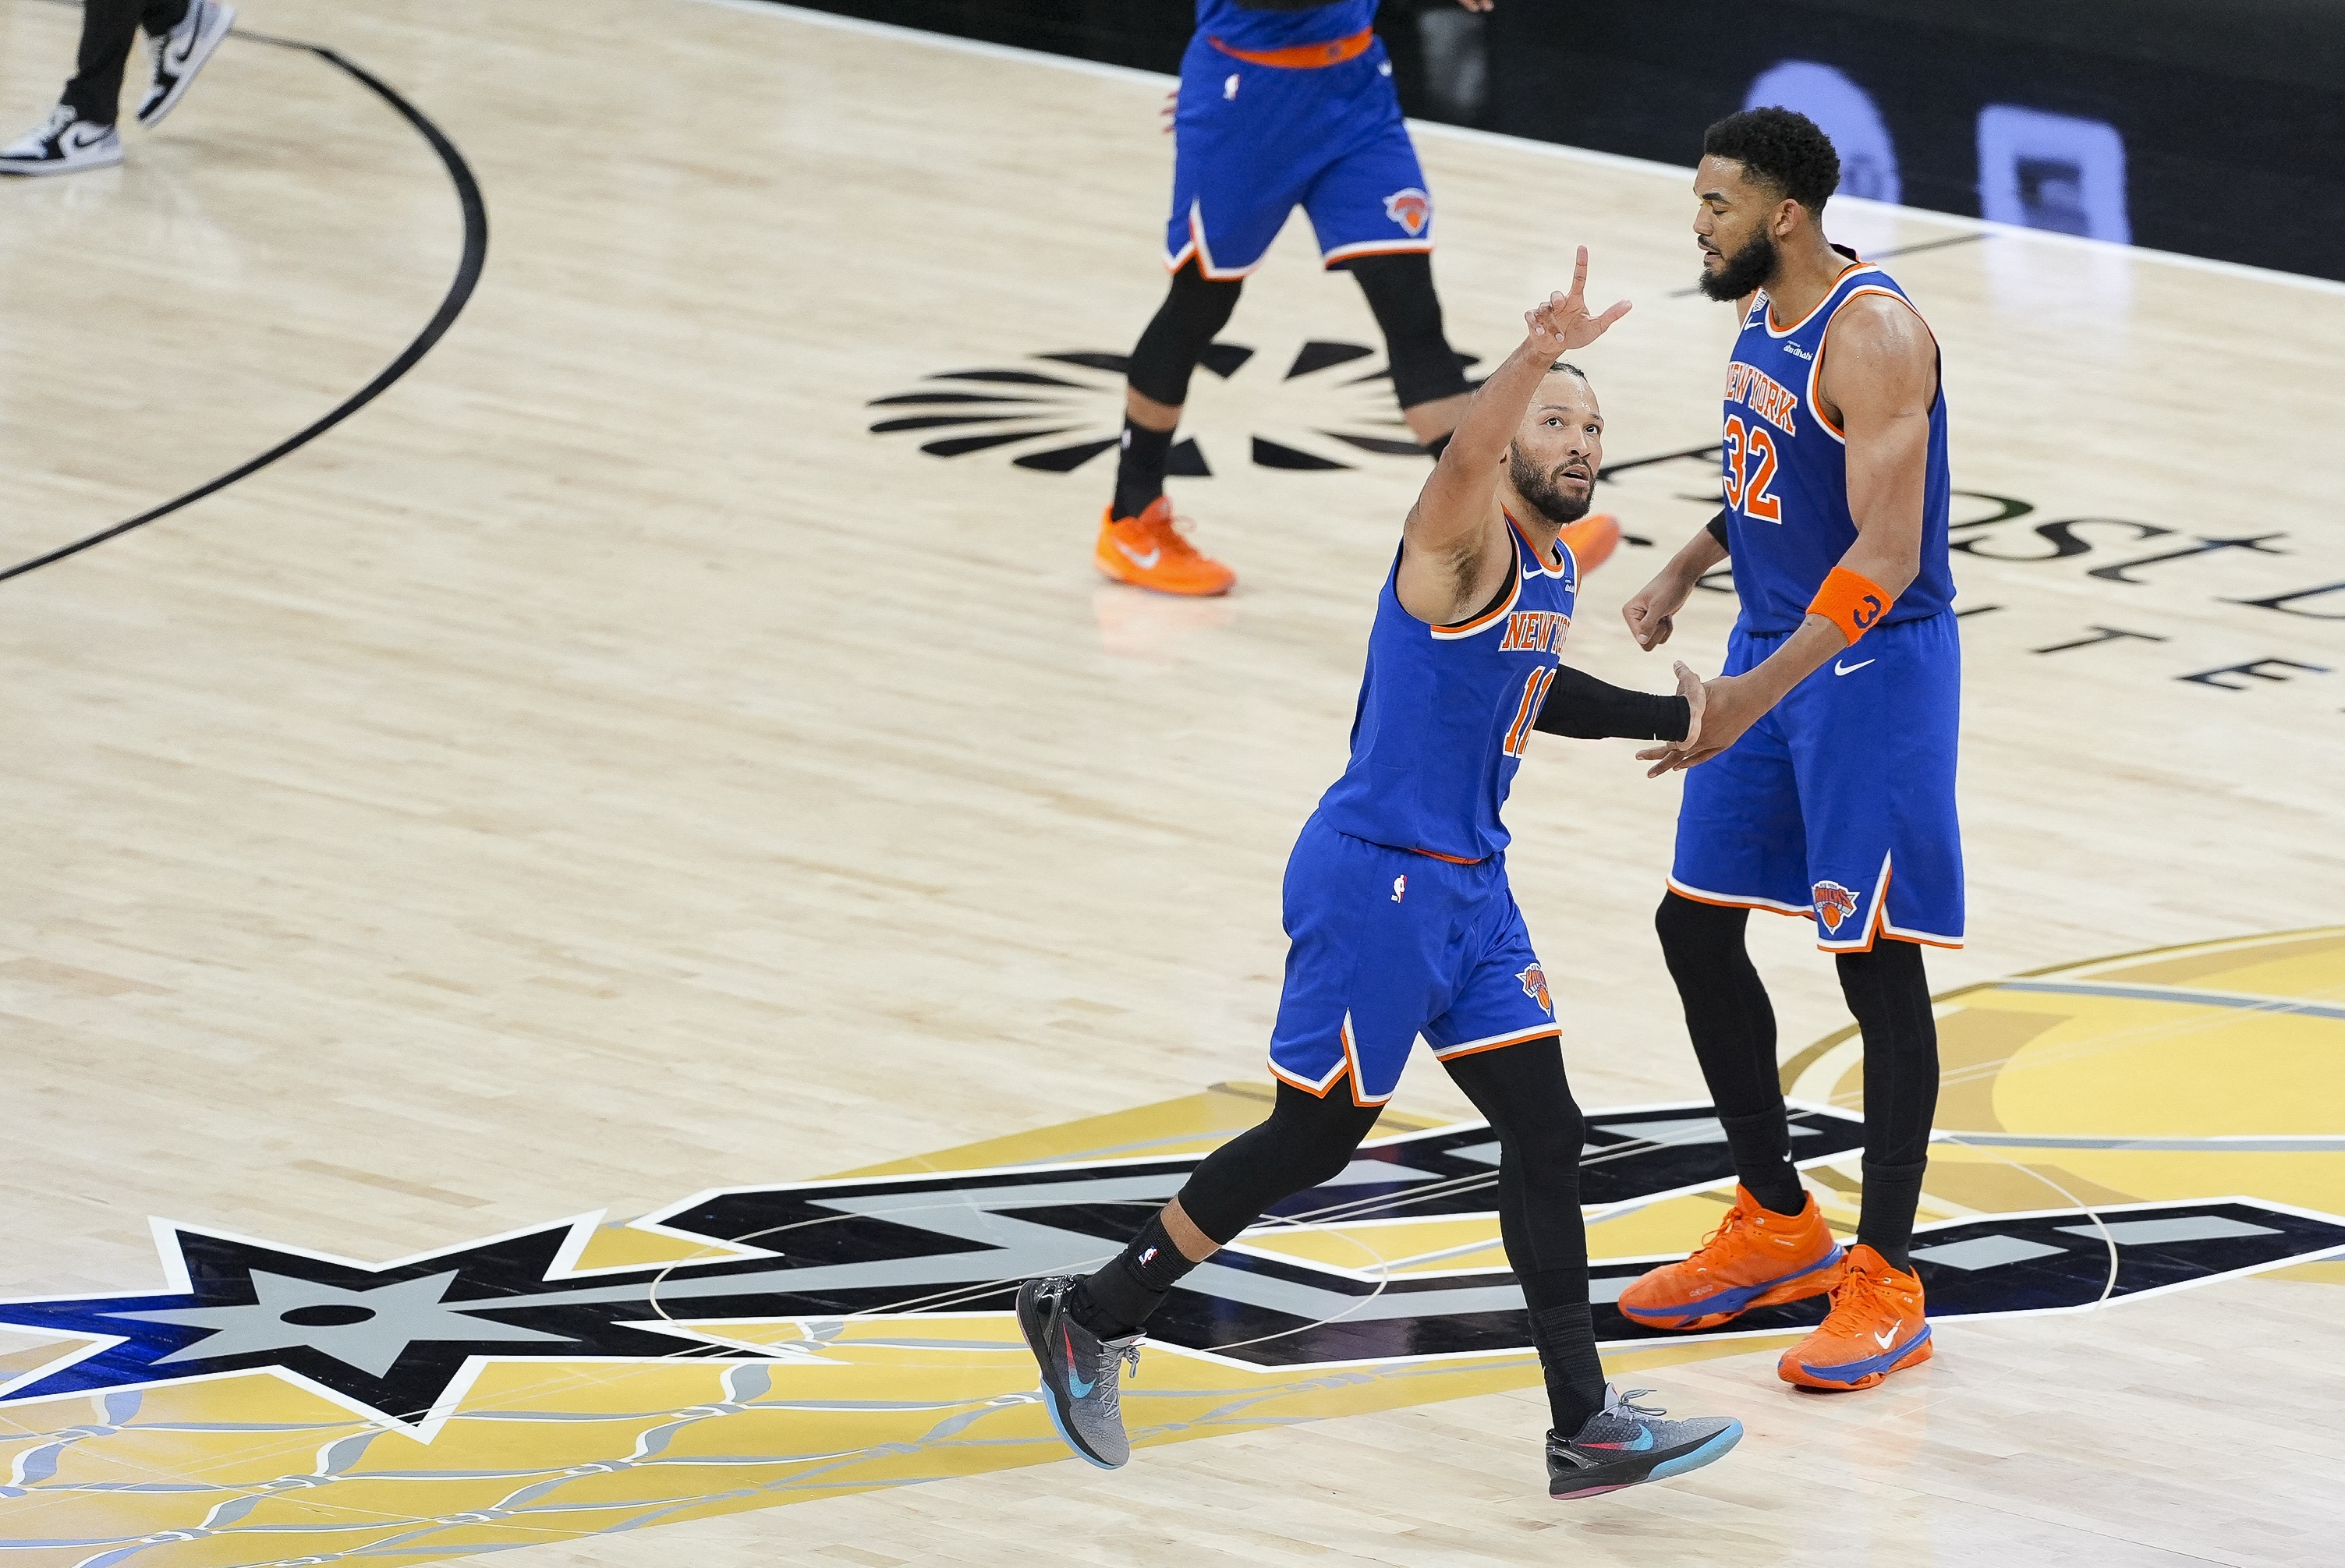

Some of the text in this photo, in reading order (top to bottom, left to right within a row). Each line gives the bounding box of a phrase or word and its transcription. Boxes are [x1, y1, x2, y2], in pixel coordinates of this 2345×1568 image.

[1748, 364, 1798, 437] YORK
[1722, 413, 1782, 525] 32
[1498, 611, 1556, 653] NEW
[1502, 665, 1557, 759] 11
